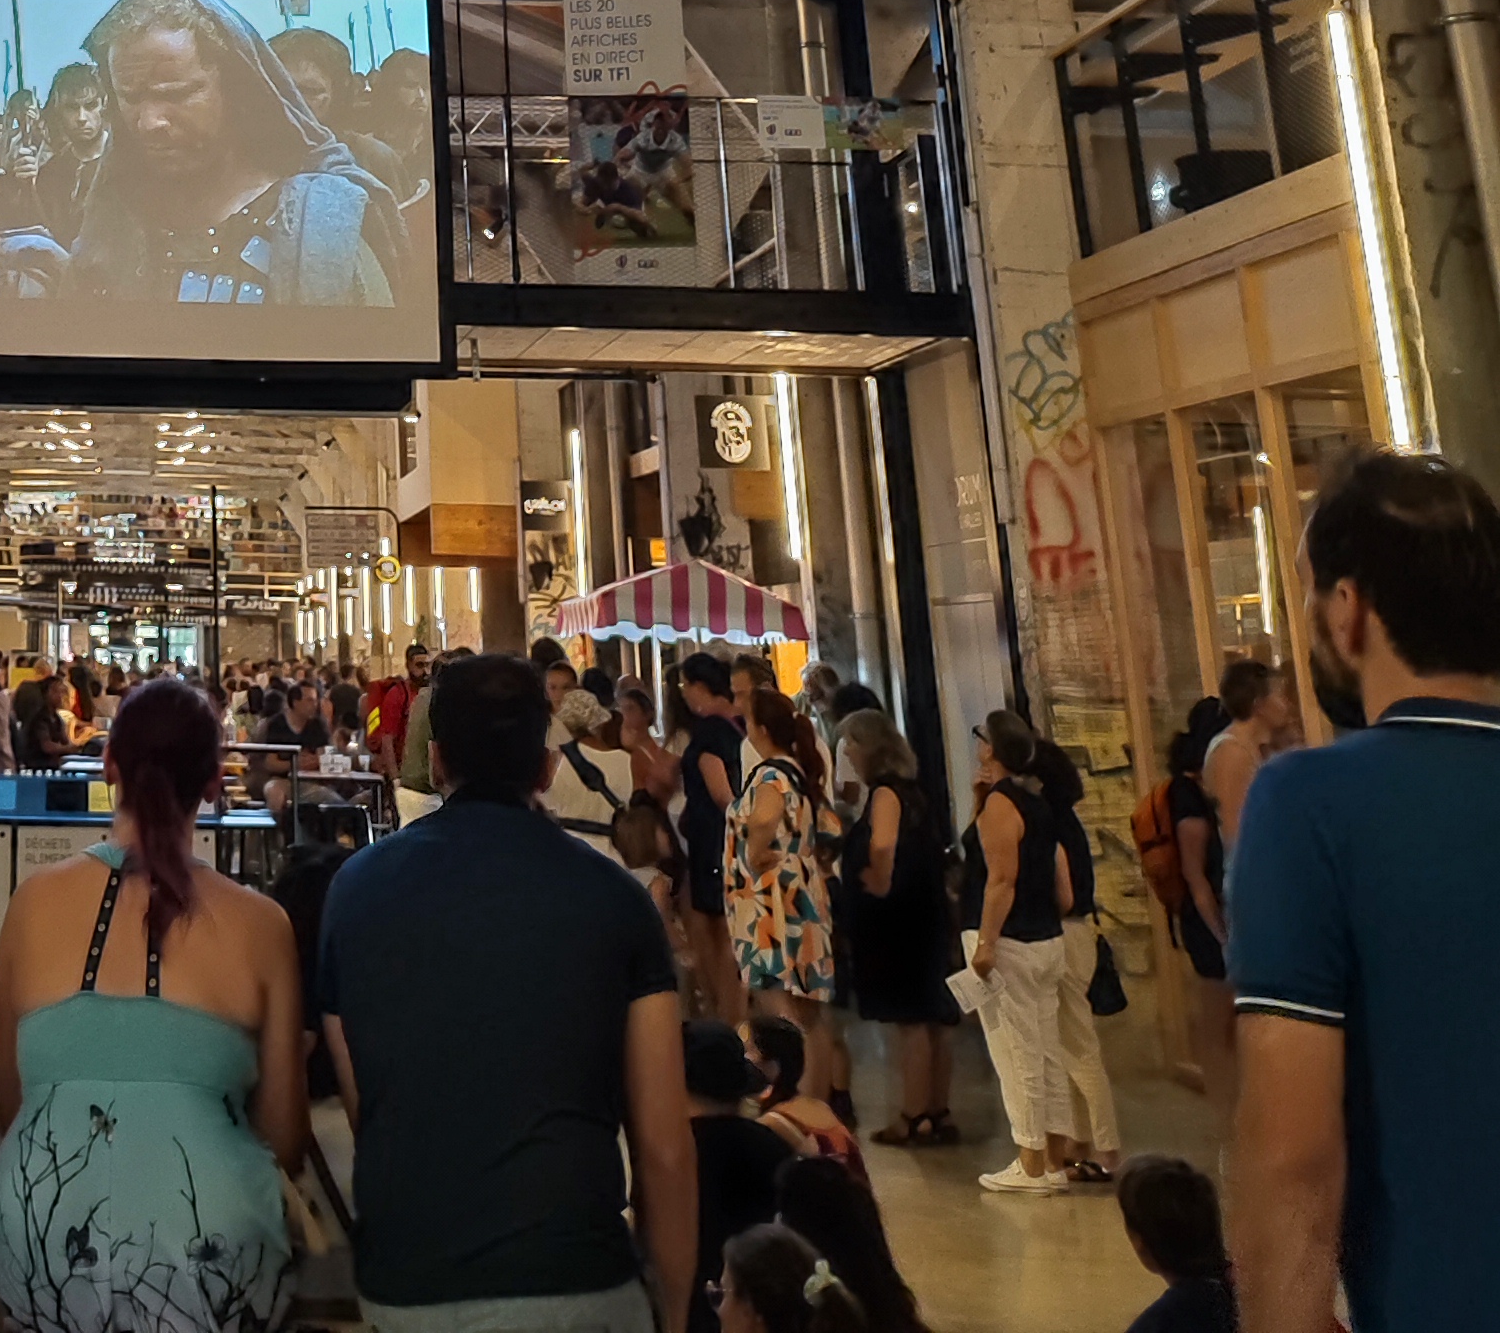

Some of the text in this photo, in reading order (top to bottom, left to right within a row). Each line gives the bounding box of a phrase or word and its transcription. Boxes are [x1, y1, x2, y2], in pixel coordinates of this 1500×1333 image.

[569, 0, 615, 13] LES 20
[570, 14, 652, 31] PLUS BELLES
[570, 33, 638, 48] AFFICHES
[572, 50, 644, 65] EN DIRECT
[573, 67, 630, 83] SUR TF1
